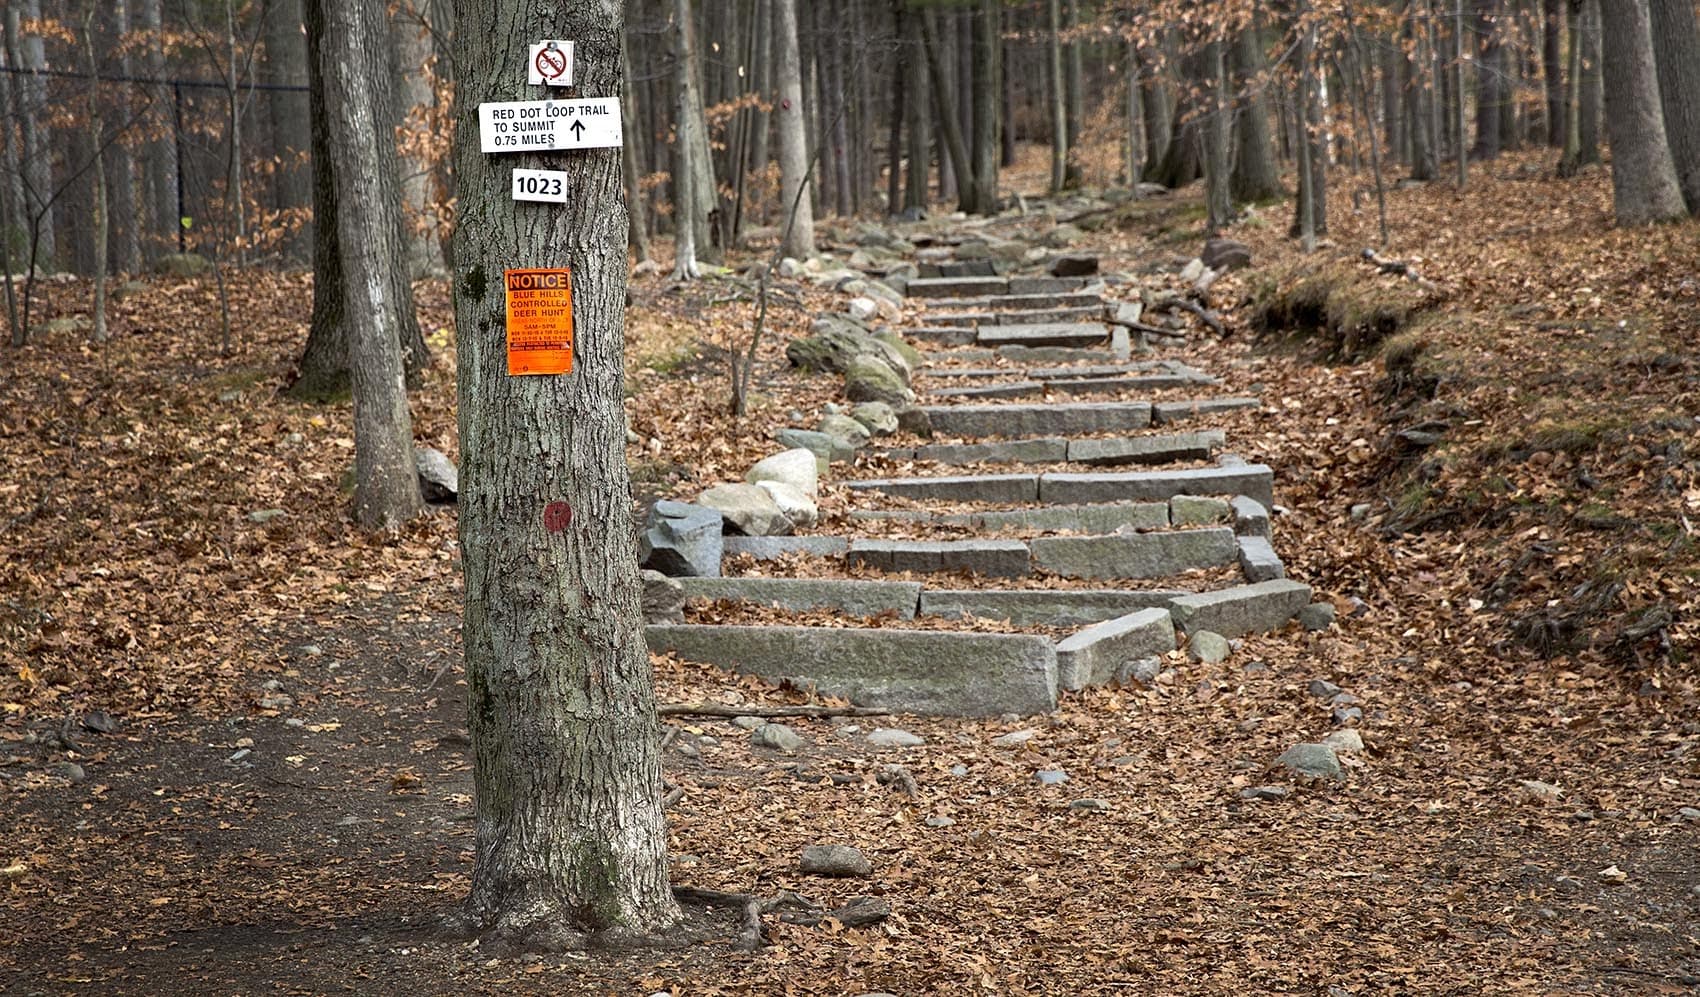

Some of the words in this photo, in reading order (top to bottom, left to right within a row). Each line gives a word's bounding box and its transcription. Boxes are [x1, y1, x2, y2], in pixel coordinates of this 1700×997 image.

[493, 109, 515, 119] RED
[520, 107, 542, 118] DOT
[546, 106, 575, 117] LOOP
[579, 105, 609, 116] TRAIL
[494, 122, 508, 132] TO
[512, 120, 556, 132] SUMMIT
[494, 135, 517, 146] 0.75
[521, 133, 555, 145] MILES
[517, 176, 562, 195] 1023
[509, 274, 567, 288] NOTICE
[513, 291, 535, 299] BLUE
[540, 290, 564, 298] HILLS
[510, 300, 568, 308] CONTROLLED
[514, 309, 537, 317] DEER
[541, 308, 565, 317] HUNT
